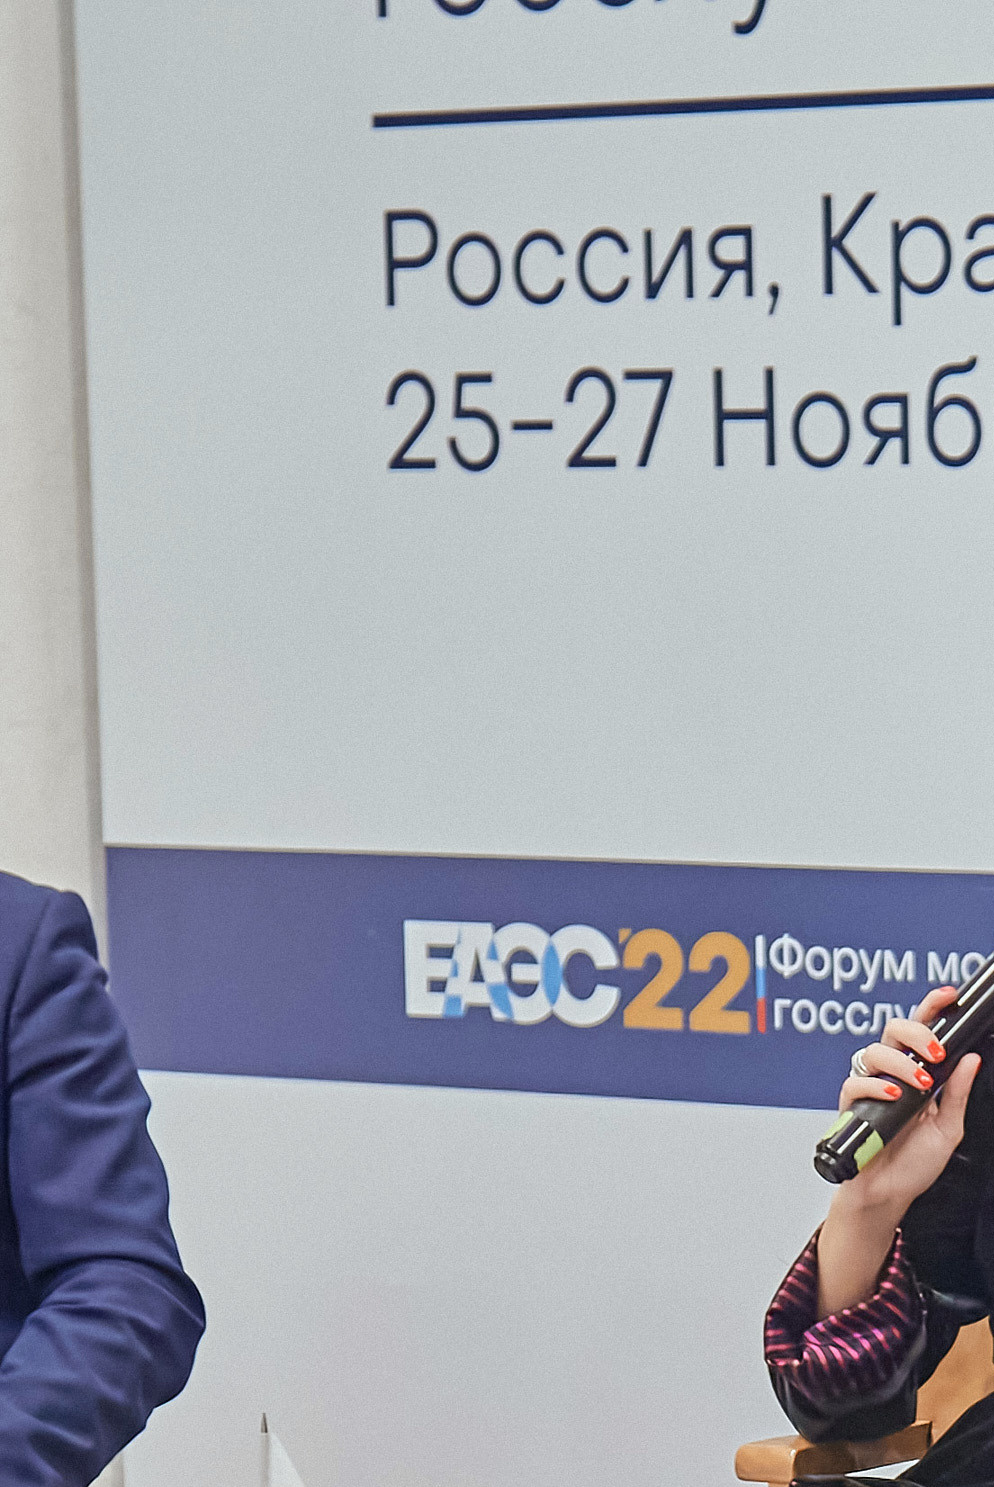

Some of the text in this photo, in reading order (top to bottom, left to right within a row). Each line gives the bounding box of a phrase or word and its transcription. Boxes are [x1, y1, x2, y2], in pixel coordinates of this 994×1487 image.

[384, 208, 780, 315] Россия,
[386, 367, 674, 473] 25-27
[769, 933, 916, 993] Форум
